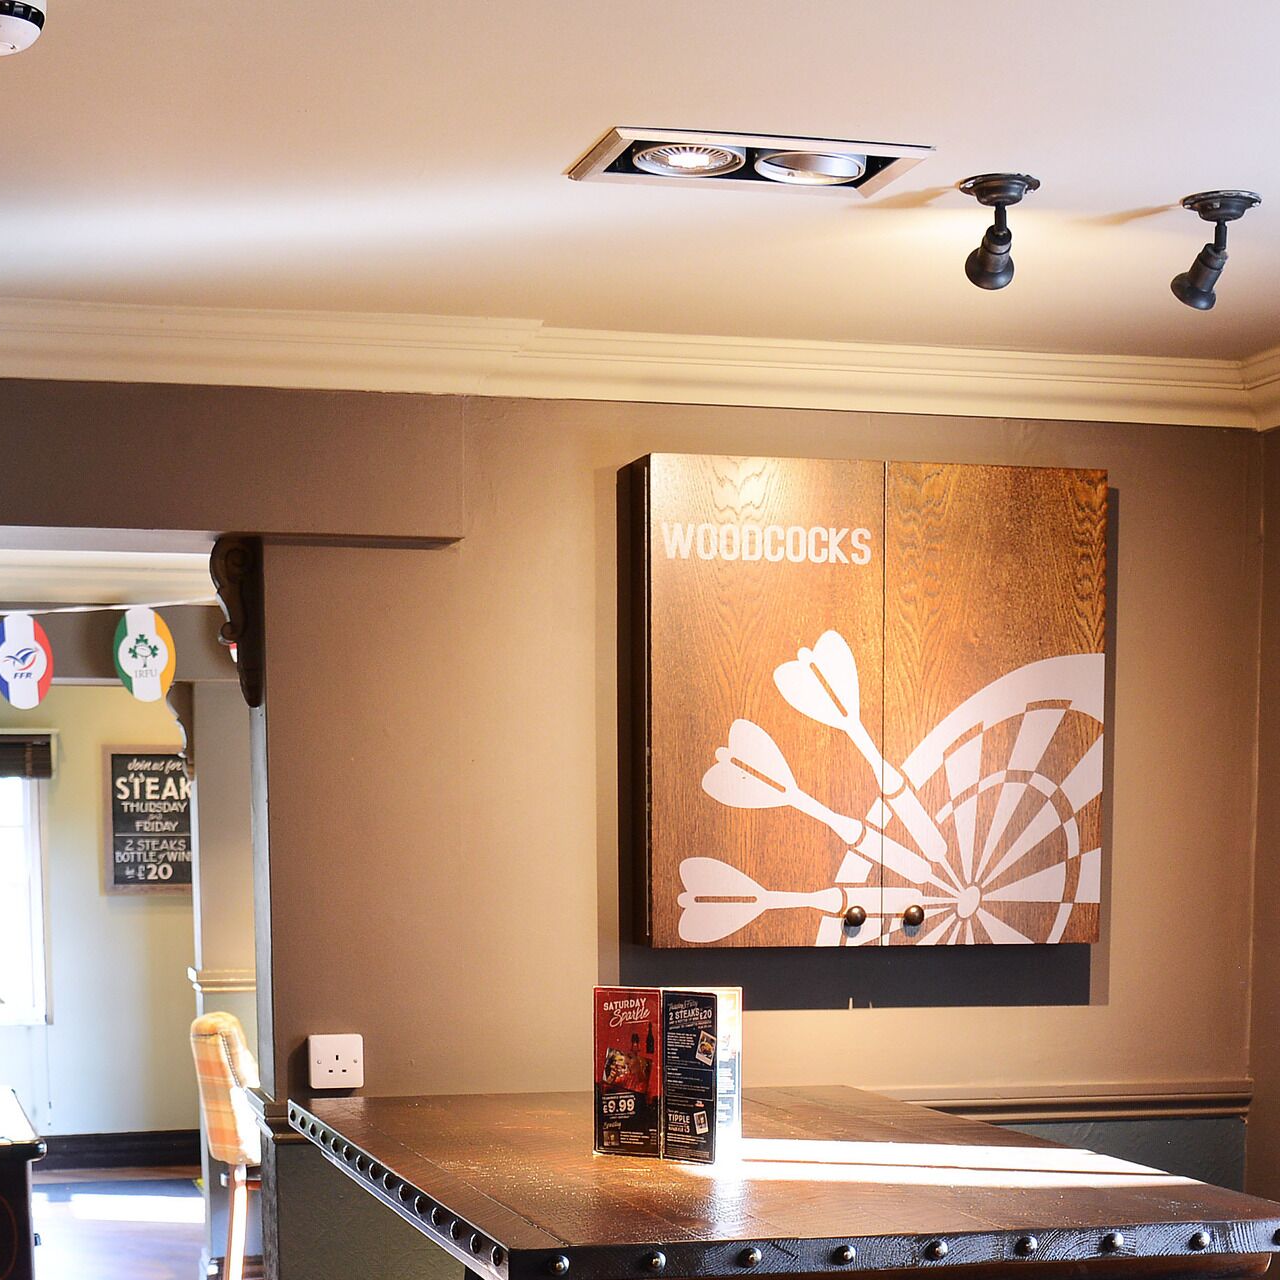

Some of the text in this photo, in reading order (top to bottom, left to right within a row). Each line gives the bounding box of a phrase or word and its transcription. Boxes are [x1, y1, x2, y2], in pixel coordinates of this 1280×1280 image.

[660, 521, 872, 565] WOODCOCKS
[134, 669, 158, 679] IRFU
[127, 758, 151, 771] Join
[164, 760, 183, 774] for
[115, 776, 192, 800] STEAK
[121, 801, 188, 813] THURSDAY
[135, 821, 179, 832] FRIDAY
[125, 839, 187, 851] 2 STEAKS
[115, 851, 158, 863] BOTTLE
[137, 863, 173, 880] £20
[603, 997, 647, 1011] SATURDAY
[610, 1006, 651, 1027] Sparkle
[668, 1011, 674, 1020] 2
[675, 1007, 700, 1020] STEAKS
[668, 1113, 690, 1124] TIPPLE
